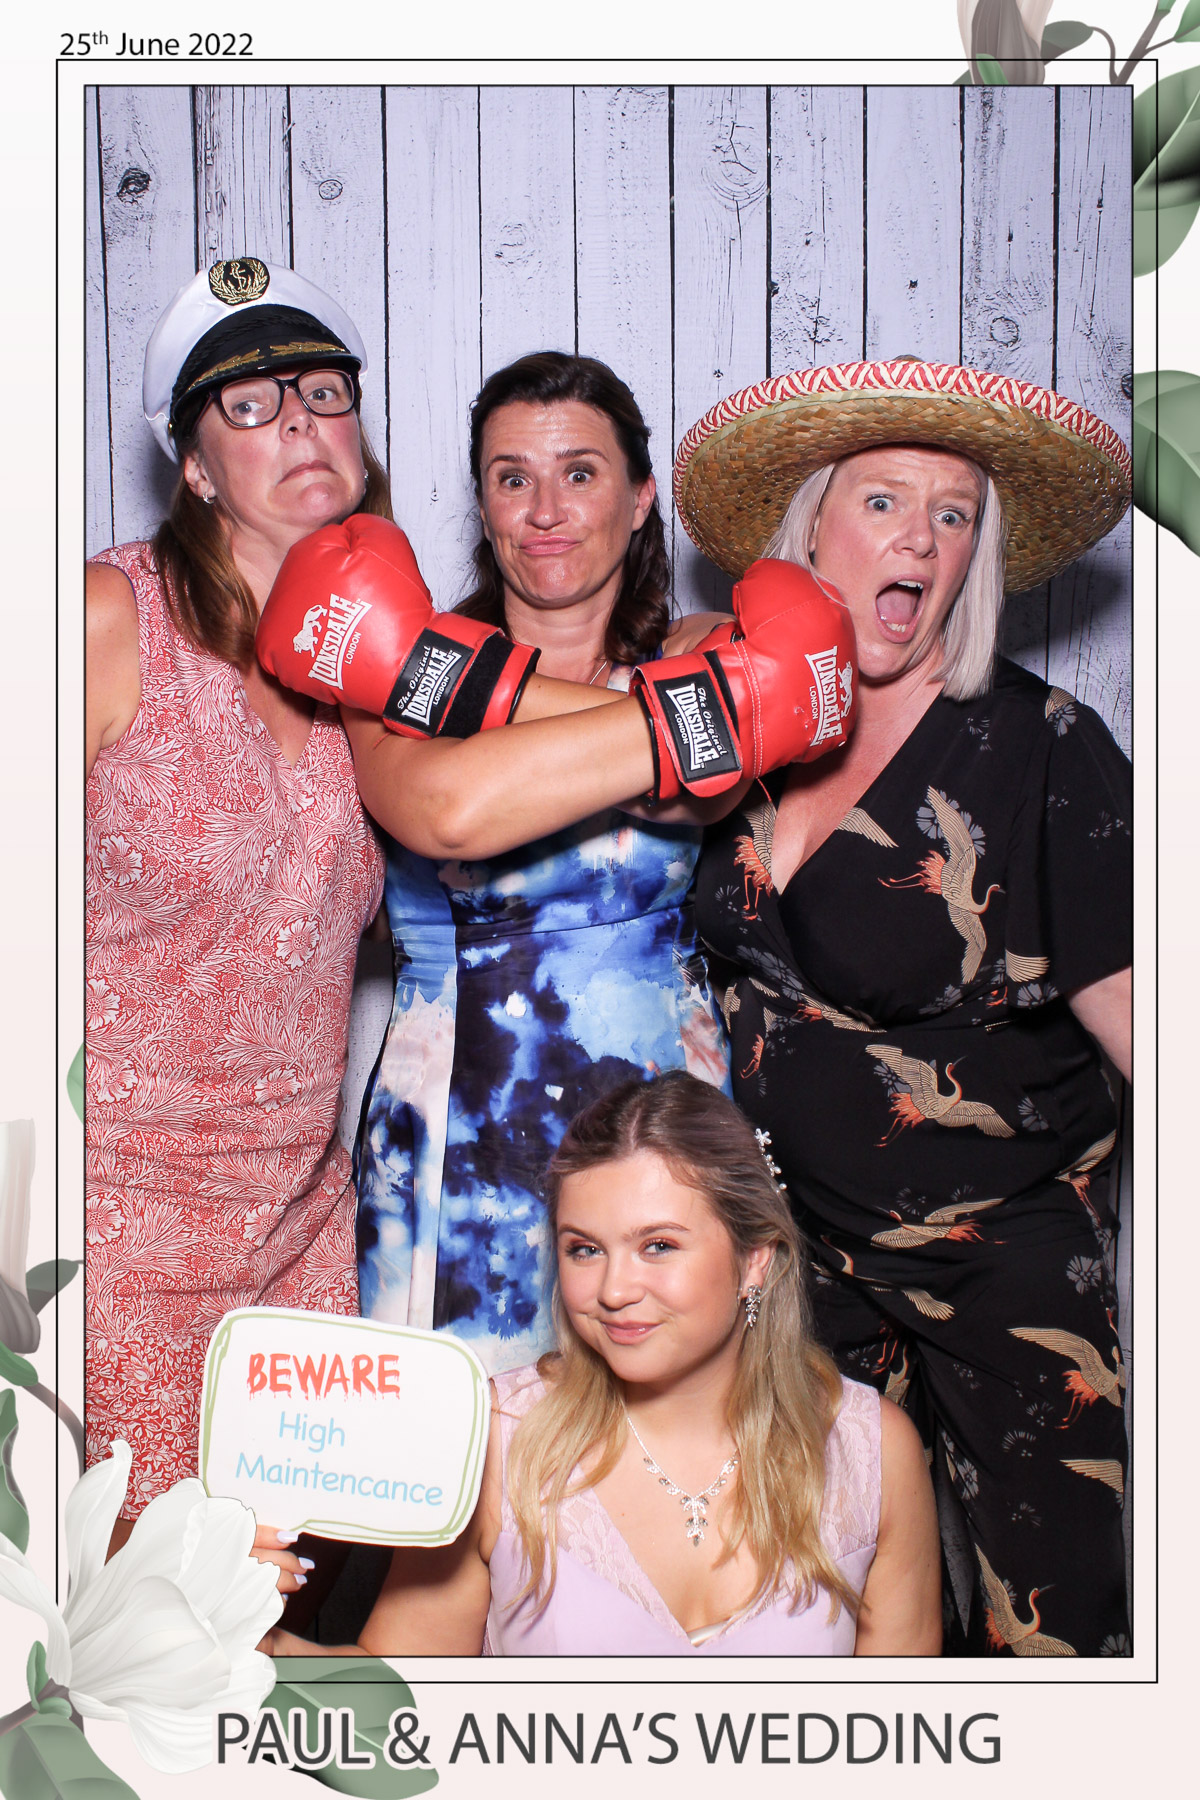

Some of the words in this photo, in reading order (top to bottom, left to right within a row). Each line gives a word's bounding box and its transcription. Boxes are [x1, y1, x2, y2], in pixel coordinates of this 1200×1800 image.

[308, 593, 372, 690] LONSDALE
[344, 632, 362, 665] LONDON
[397, 690, 413, 710] The
[409, 645, 431, 690] Original
[401, 646, 462, 726] LONSDALE
[432, 676, 449, 705] LONDON
[804, 645, 843, 747] LONSDALE
[809, 685, 818, 720] LONDON
[665, 682, 720, 771] LONSDALE
[674, 713, 689, 745] LONDON
[697, 687, 707, 708] The
[703, 708, 727, 756] Original
[247, 1353, 401, 1400] BEWARE
[279, 1411, 345, 1452] High
[235, 1452, 443, 1506] Maintencance
